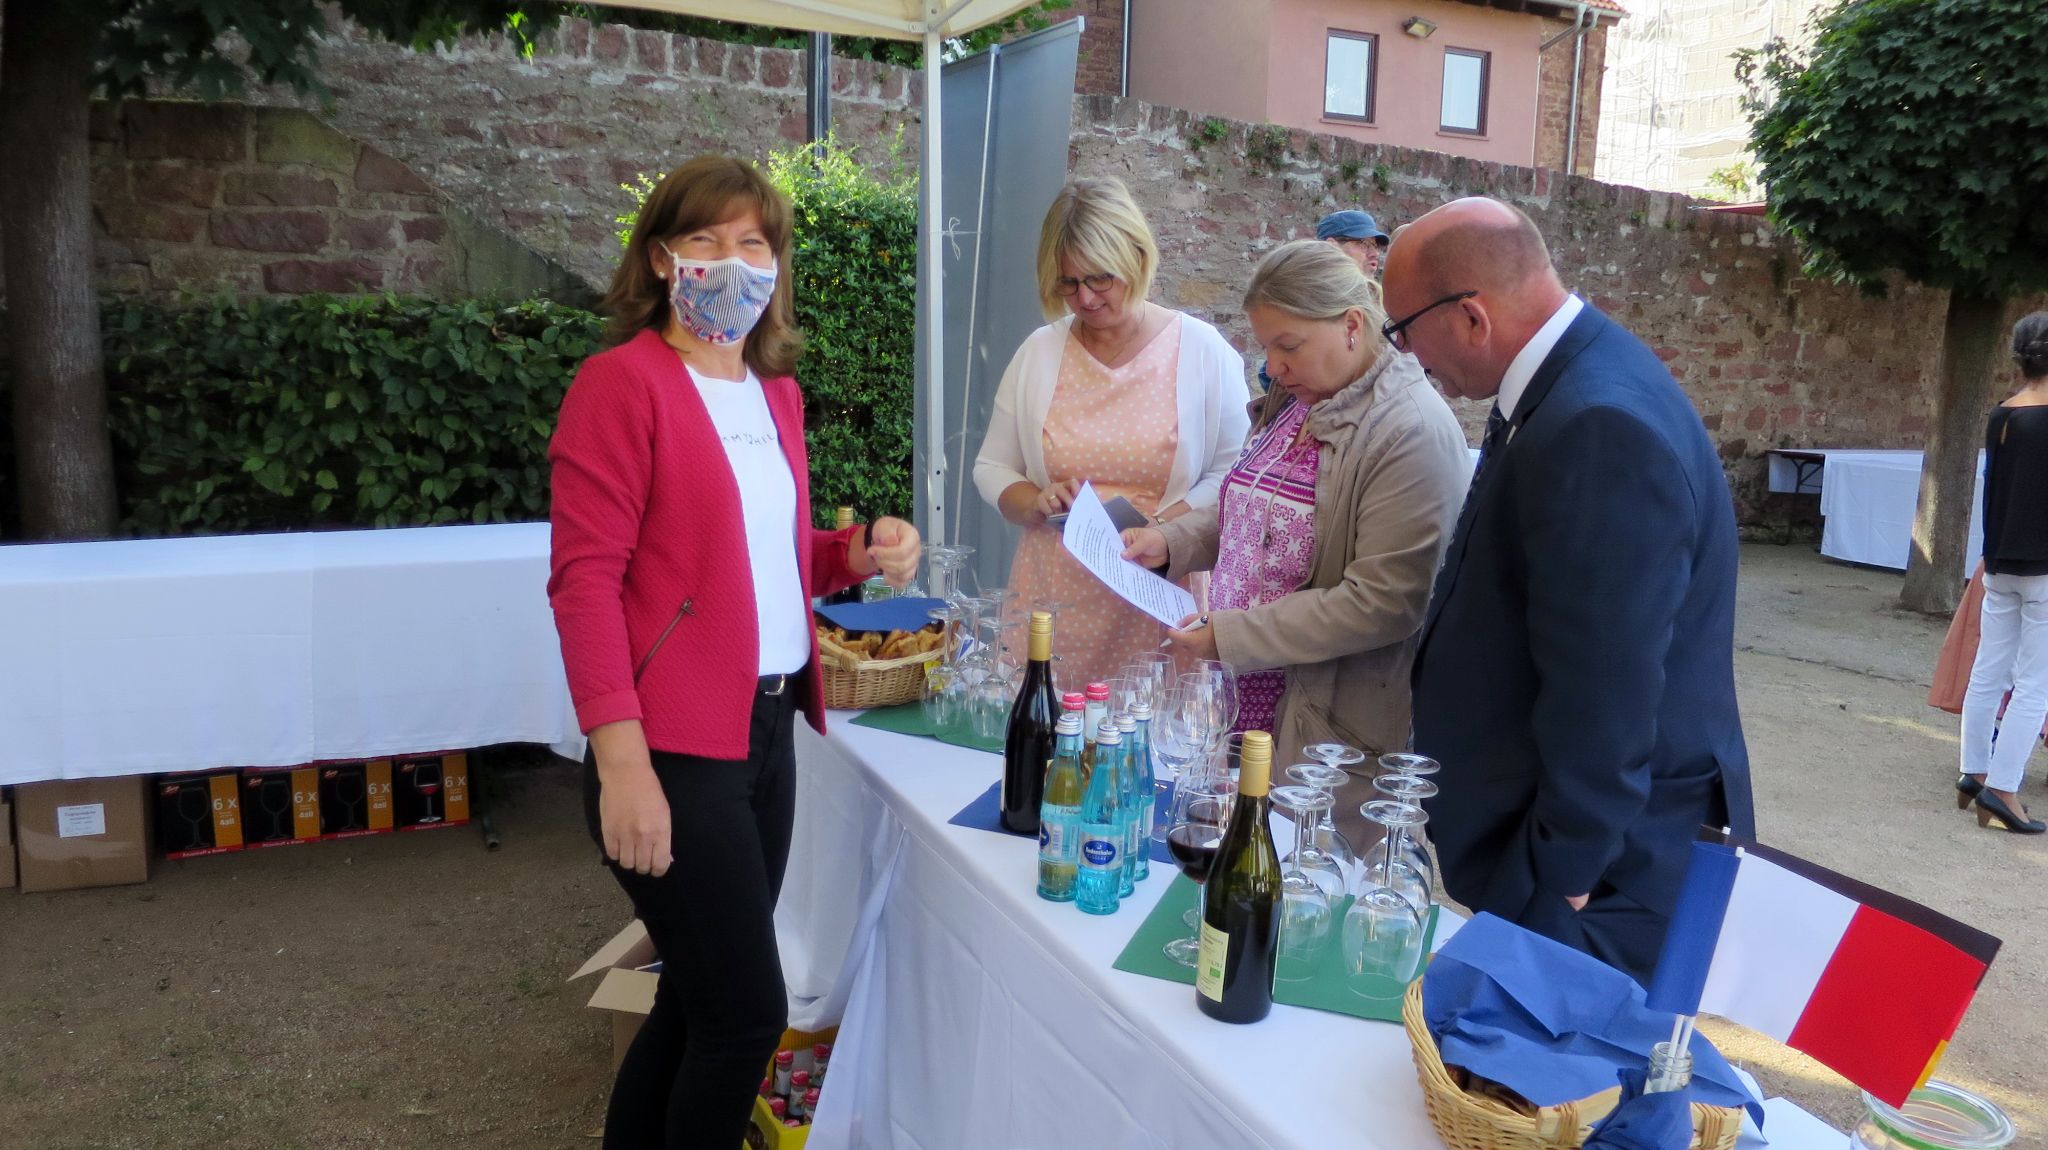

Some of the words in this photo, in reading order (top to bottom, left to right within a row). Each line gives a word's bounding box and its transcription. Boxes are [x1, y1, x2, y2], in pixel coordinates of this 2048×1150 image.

[444, 776, 454, 788] 6
[368, 782, 377, 795] 6
[294, 791, 304, 803] 6
[213, 798, 224, 811] 6
